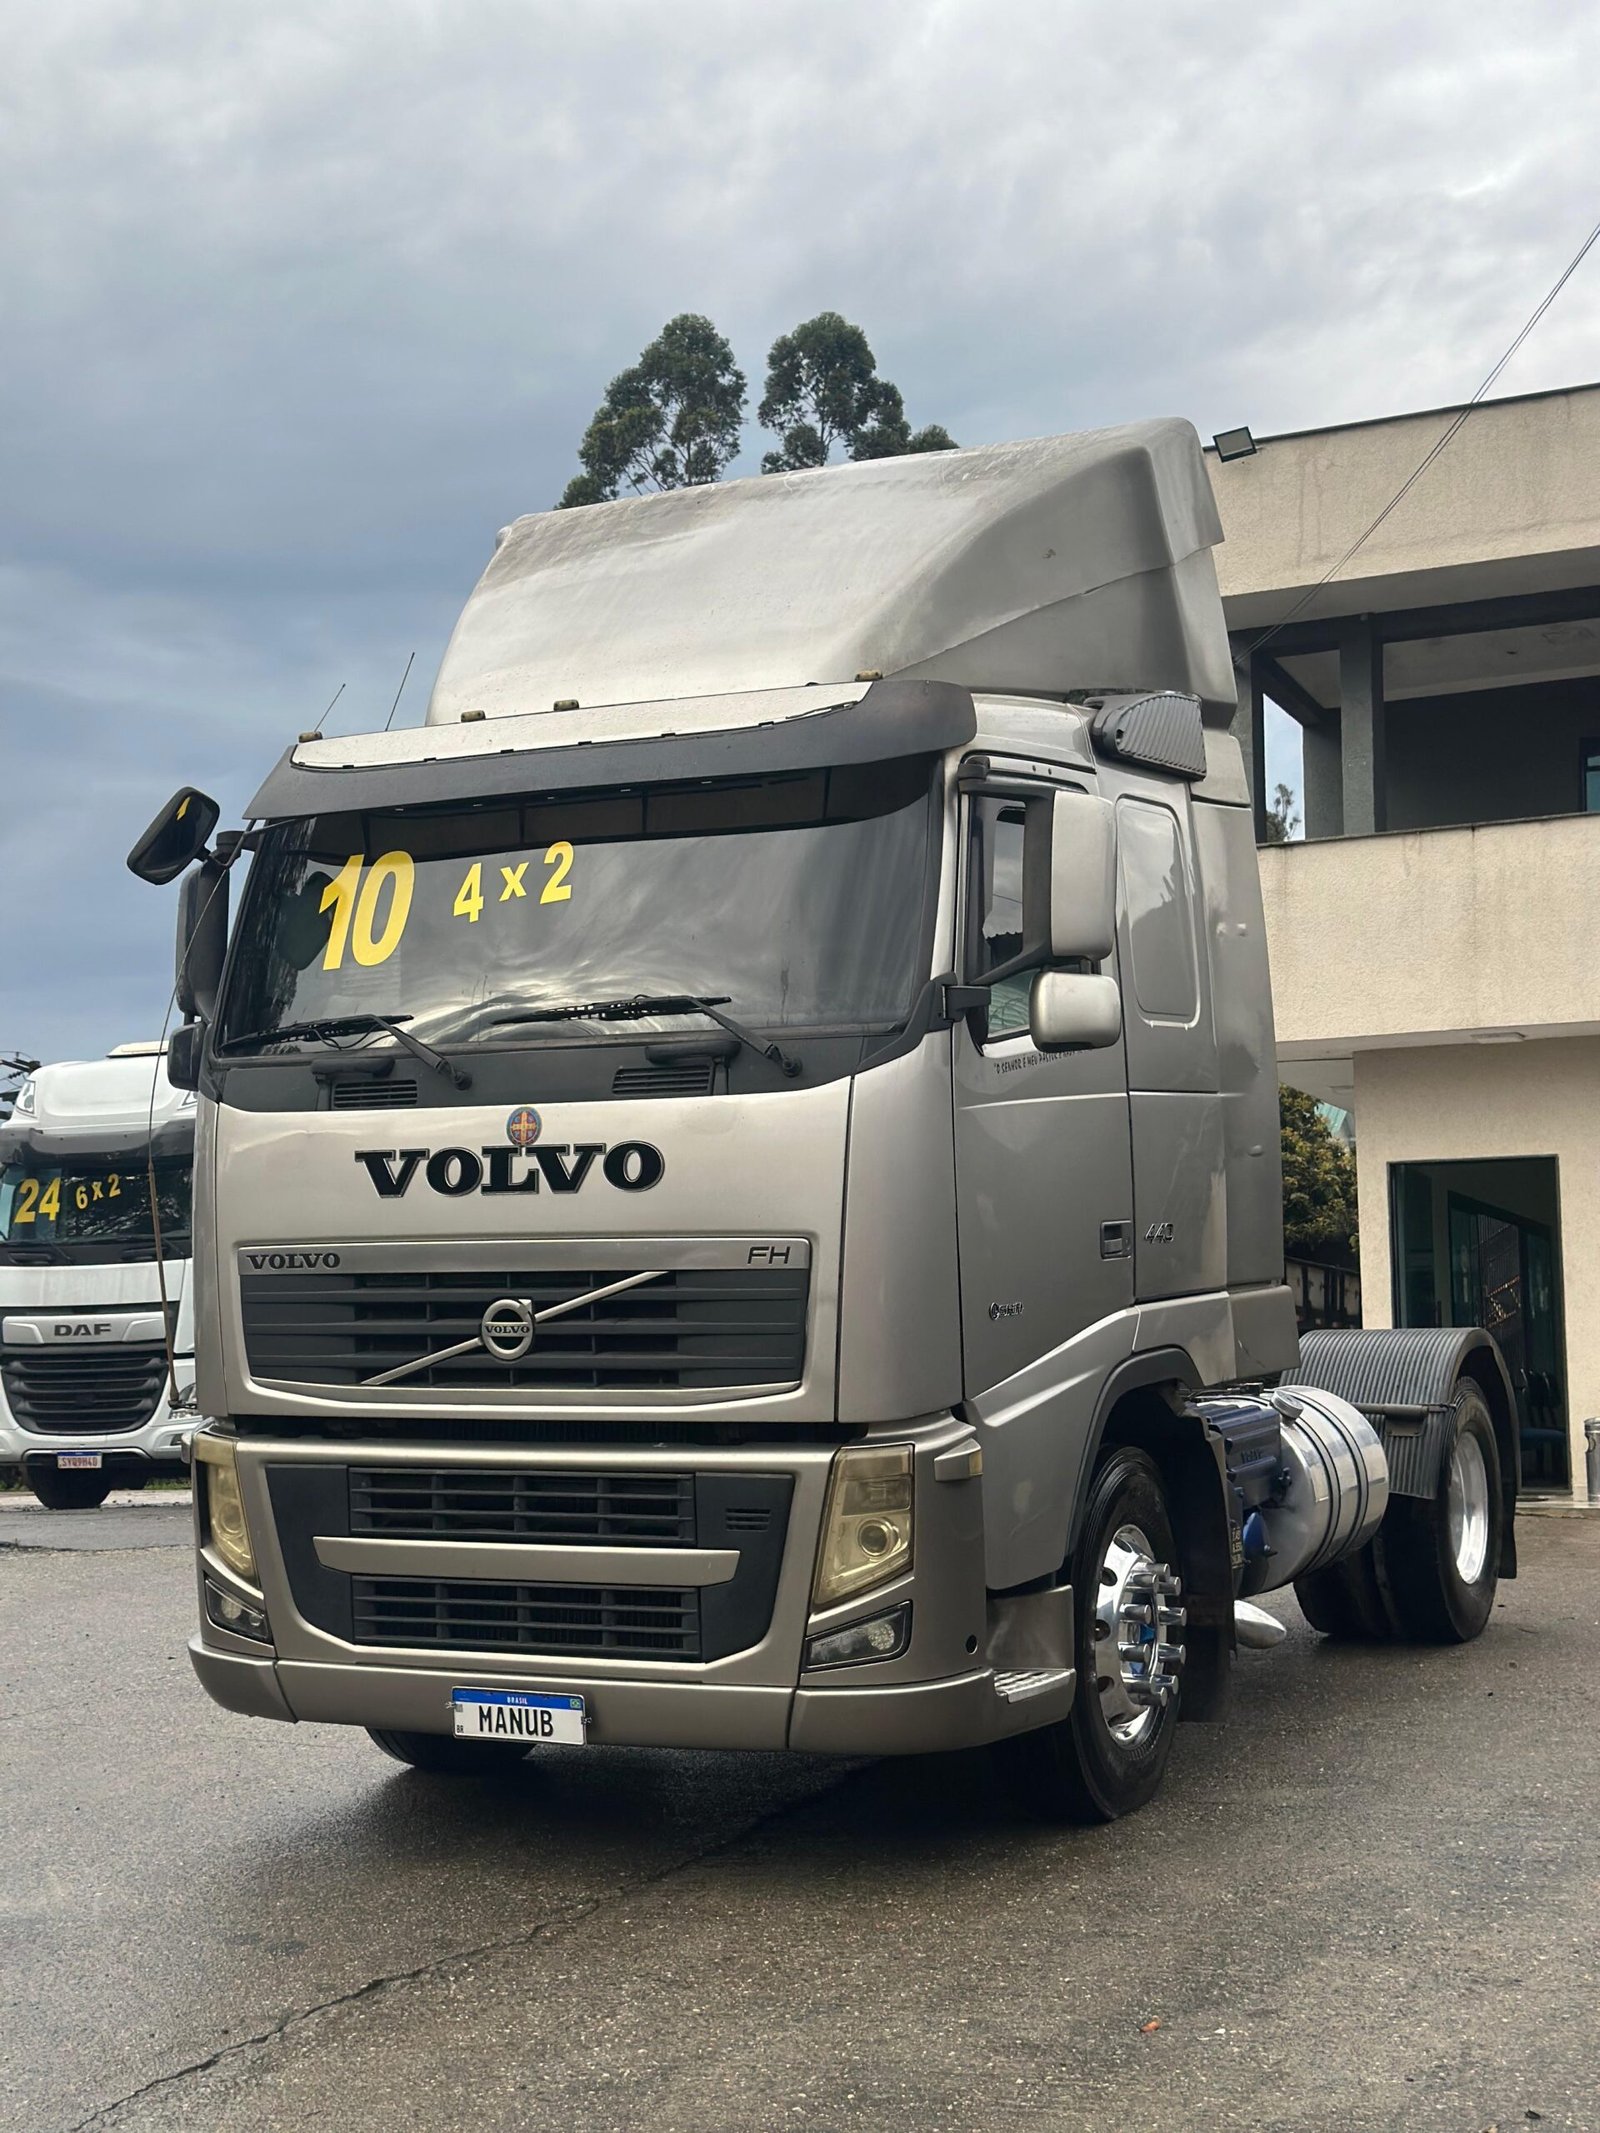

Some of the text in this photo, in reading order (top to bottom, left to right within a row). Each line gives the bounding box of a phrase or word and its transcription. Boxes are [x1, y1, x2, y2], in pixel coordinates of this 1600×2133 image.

[319, 849, 415, 970] 10
[355, 1140, 665, 1198] VOLVO
[14, 1177, 61, 1223] 24
[246, 1252, 341, 1270] VOLVO
[747, 1246, 791, 1264] FH
[54, 1323, 112, 1337] DAF
[485, 1325, 530, 1334] VOLVO
[506, 1696, 528, 1705] BRASIL
[478, 1704, 554, 1737] MANUB
